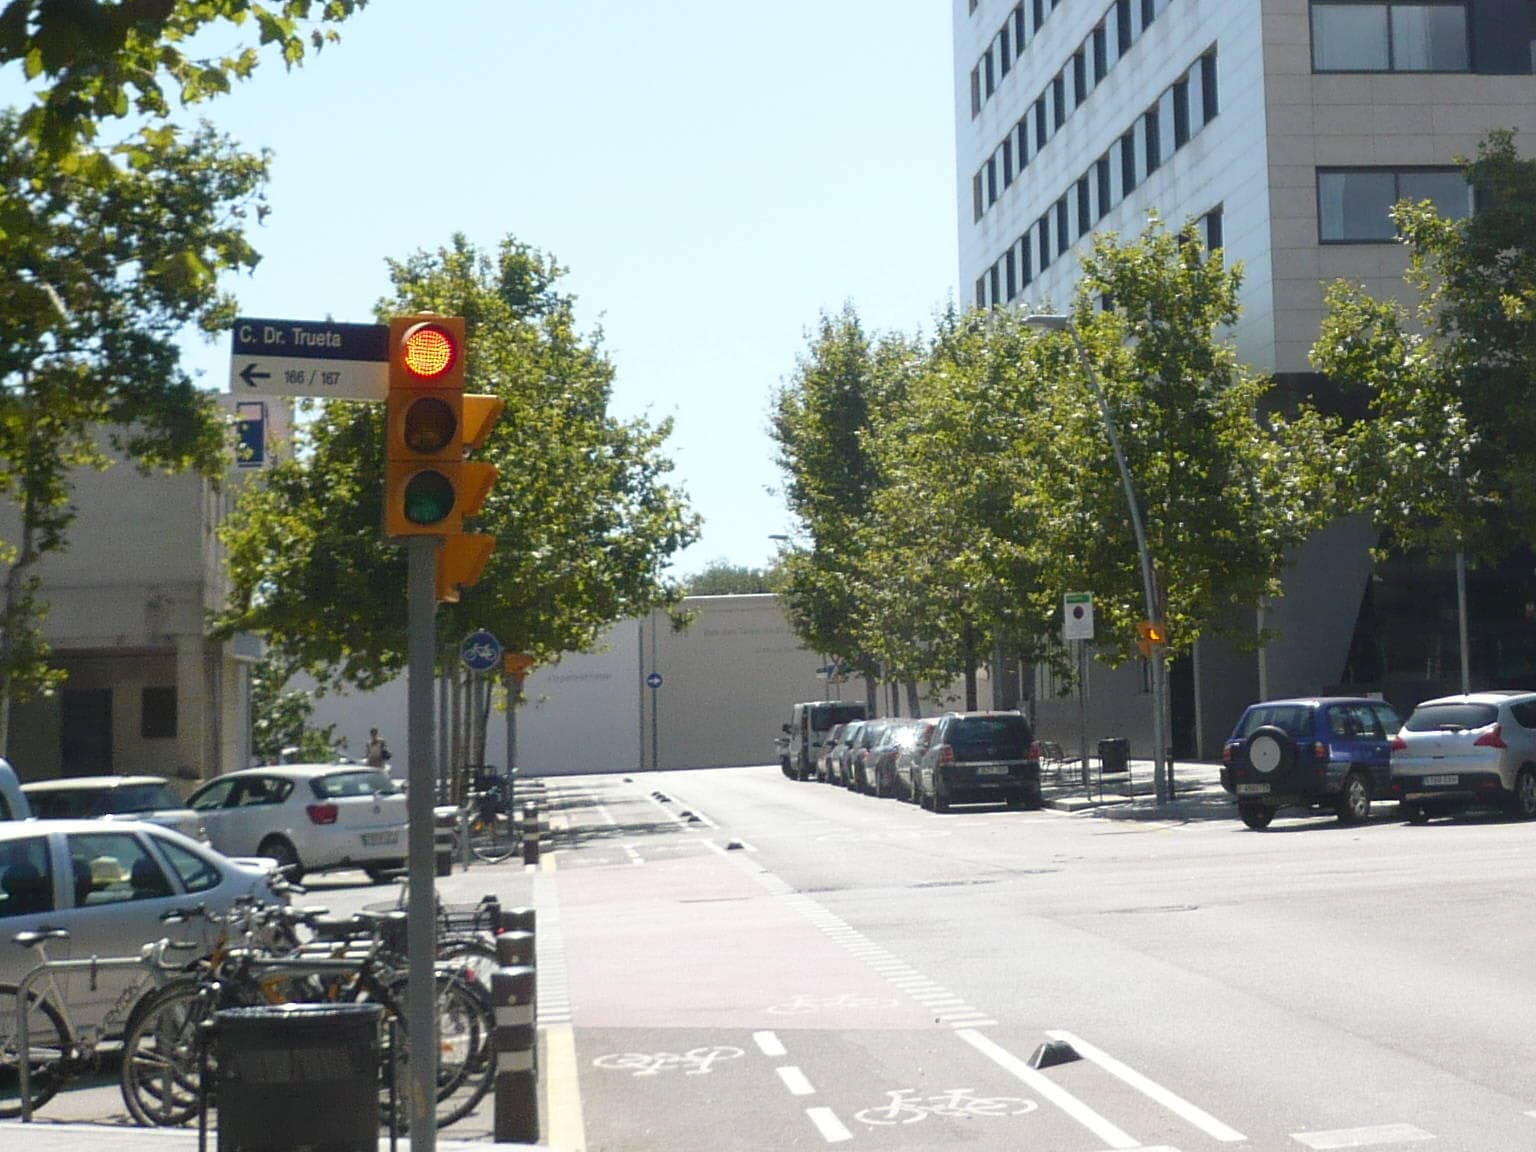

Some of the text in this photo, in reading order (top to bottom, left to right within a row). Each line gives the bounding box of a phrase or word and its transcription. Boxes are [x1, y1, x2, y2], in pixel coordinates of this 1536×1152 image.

[239, 325, 342, 347] C. Dr. Trueta
